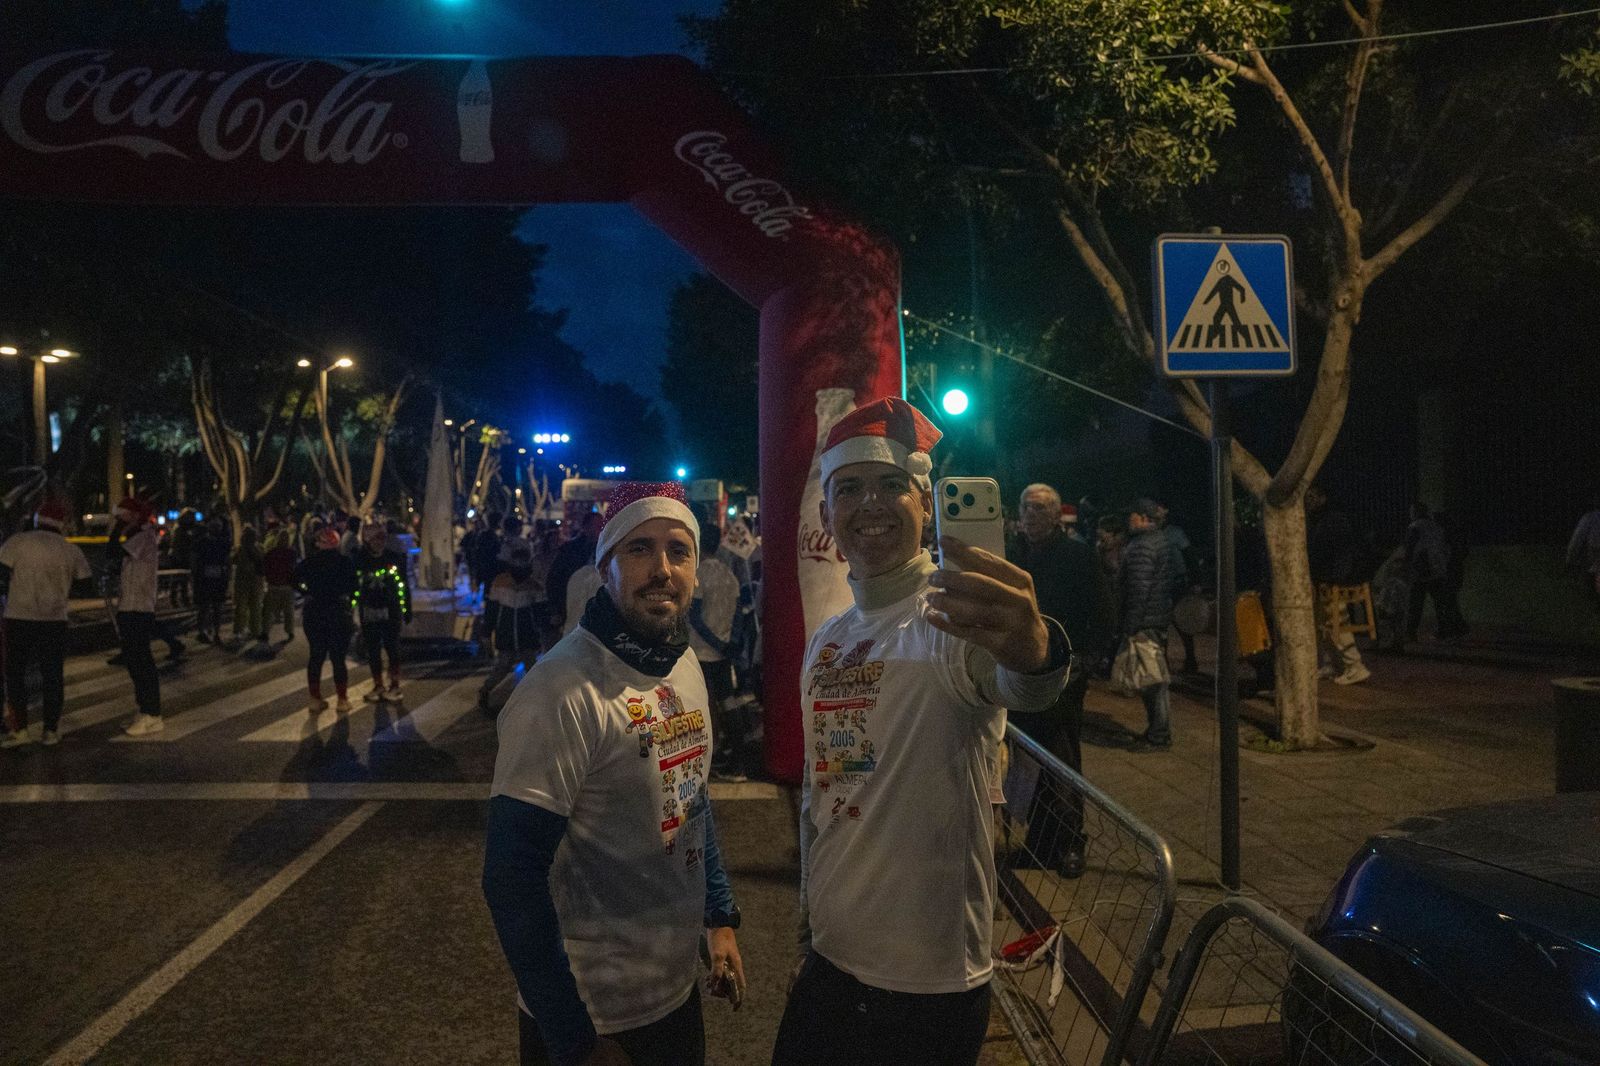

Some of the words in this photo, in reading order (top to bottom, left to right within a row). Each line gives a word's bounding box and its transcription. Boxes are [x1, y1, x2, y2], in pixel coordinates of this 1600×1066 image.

[0, 48, 418, 164] Coca-Cola
[829, 729, 855, 748] 2005
[678, 777, 697, 800] 2005
